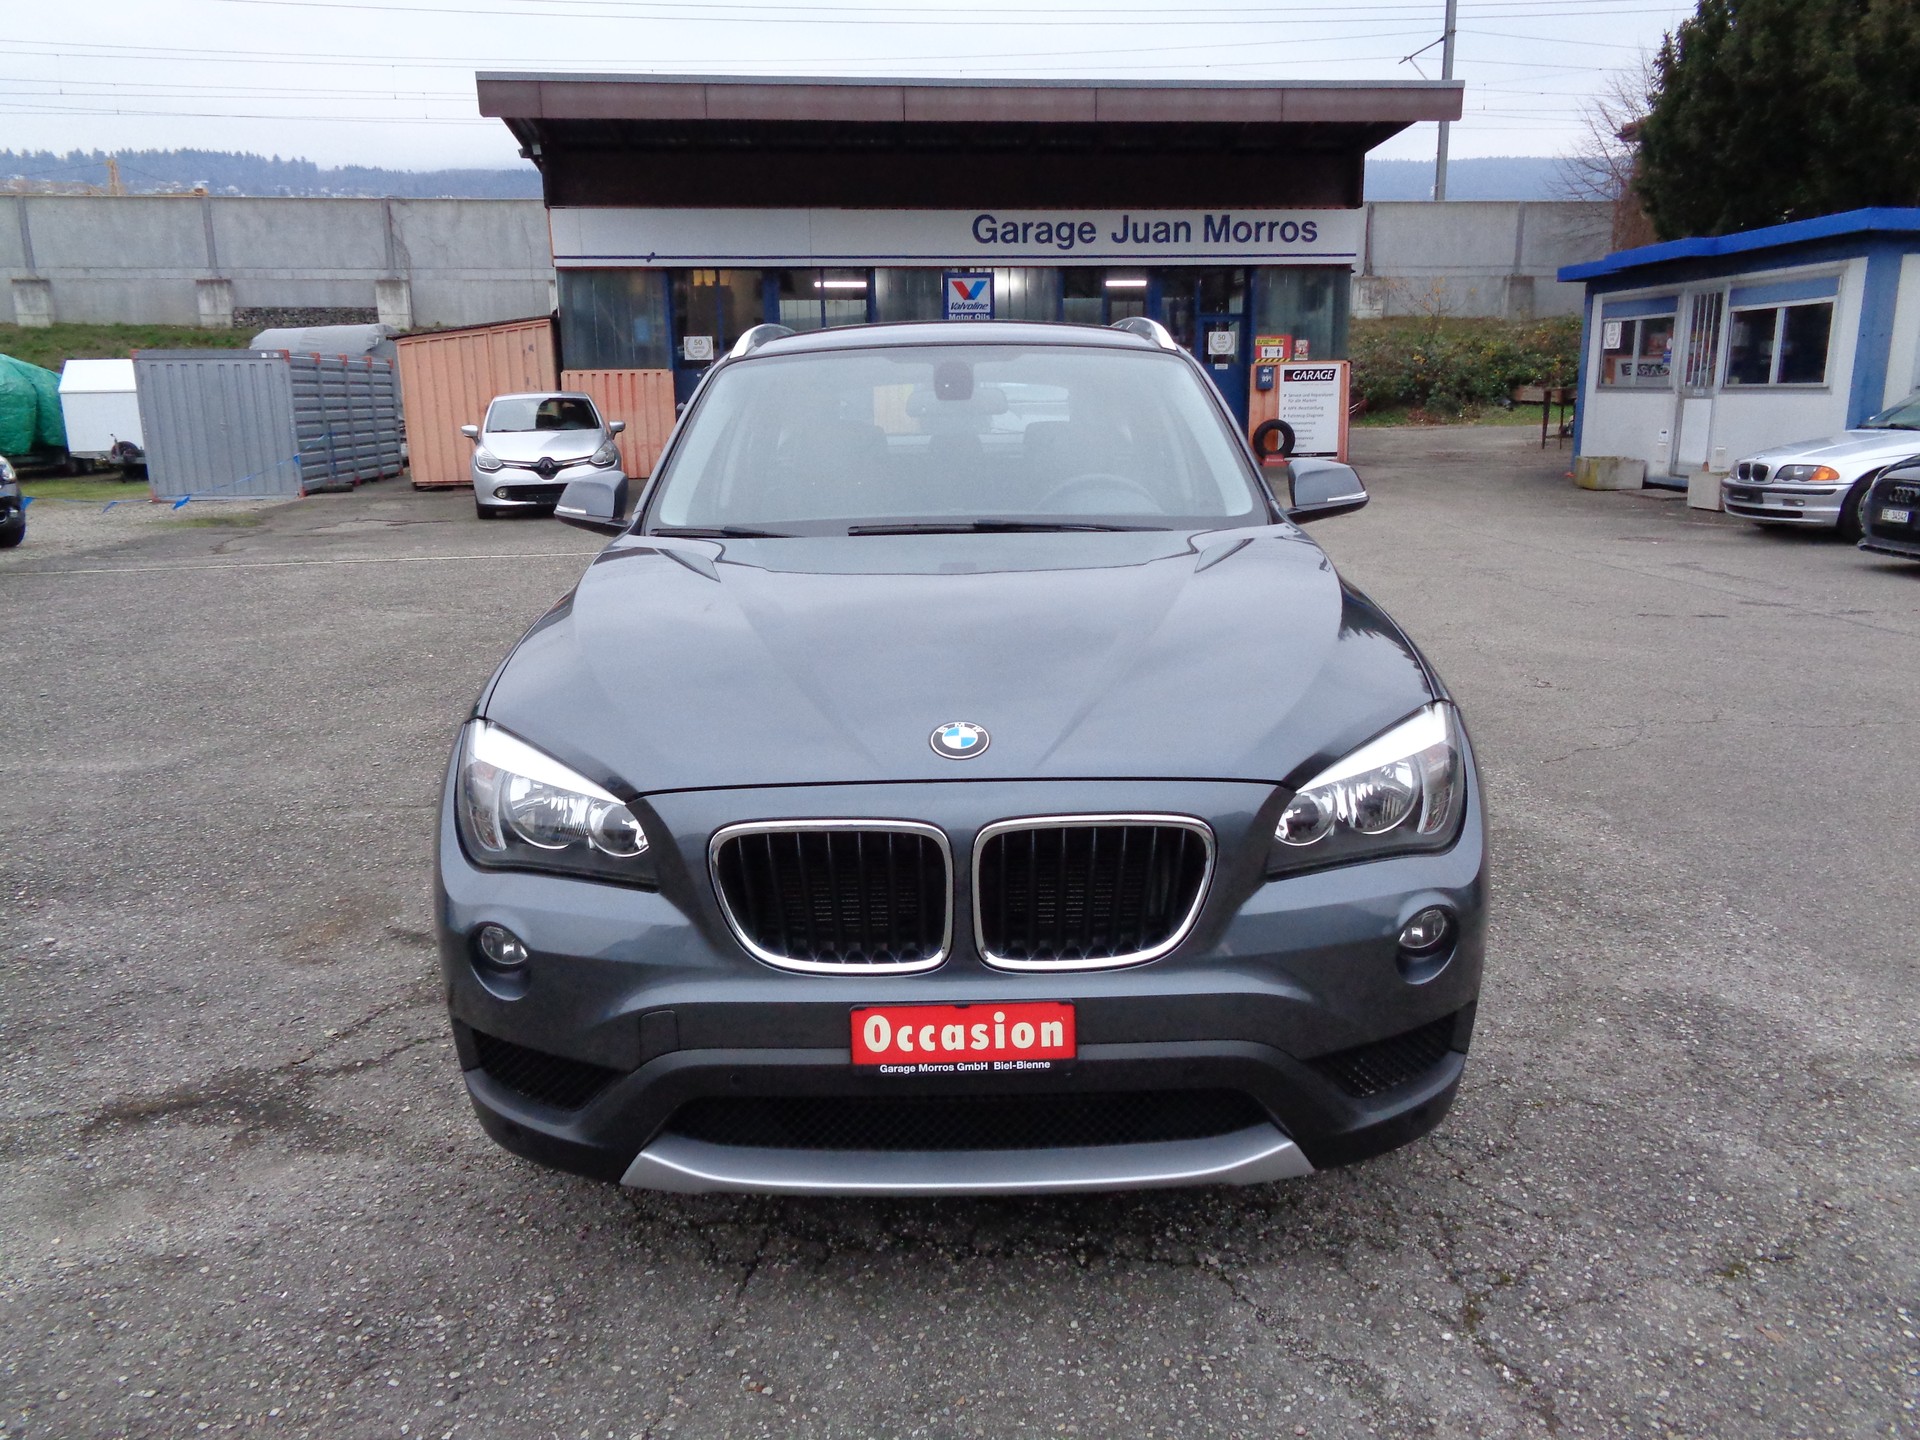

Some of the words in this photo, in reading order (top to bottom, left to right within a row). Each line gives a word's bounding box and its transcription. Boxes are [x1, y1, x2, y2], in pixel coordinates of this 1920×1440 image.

[972, 214, 1097, 250] Garage
[1111, 214, 1192, 244] Juan
[1203, 214, 1318, 244] Morros
[951, 302, 989, 311] Valvoline
[1292, 369, 1334, 381] GARAGE
[863, 1011, 1064, 1053] Occasion
[879, 1064, 916, 1074] Garage
[918, 1063, 955, 1072] Morros
[957, 1062, 988, 1071] GmbH
[993, 1060, 1051, 1070] Biel-Bienne
